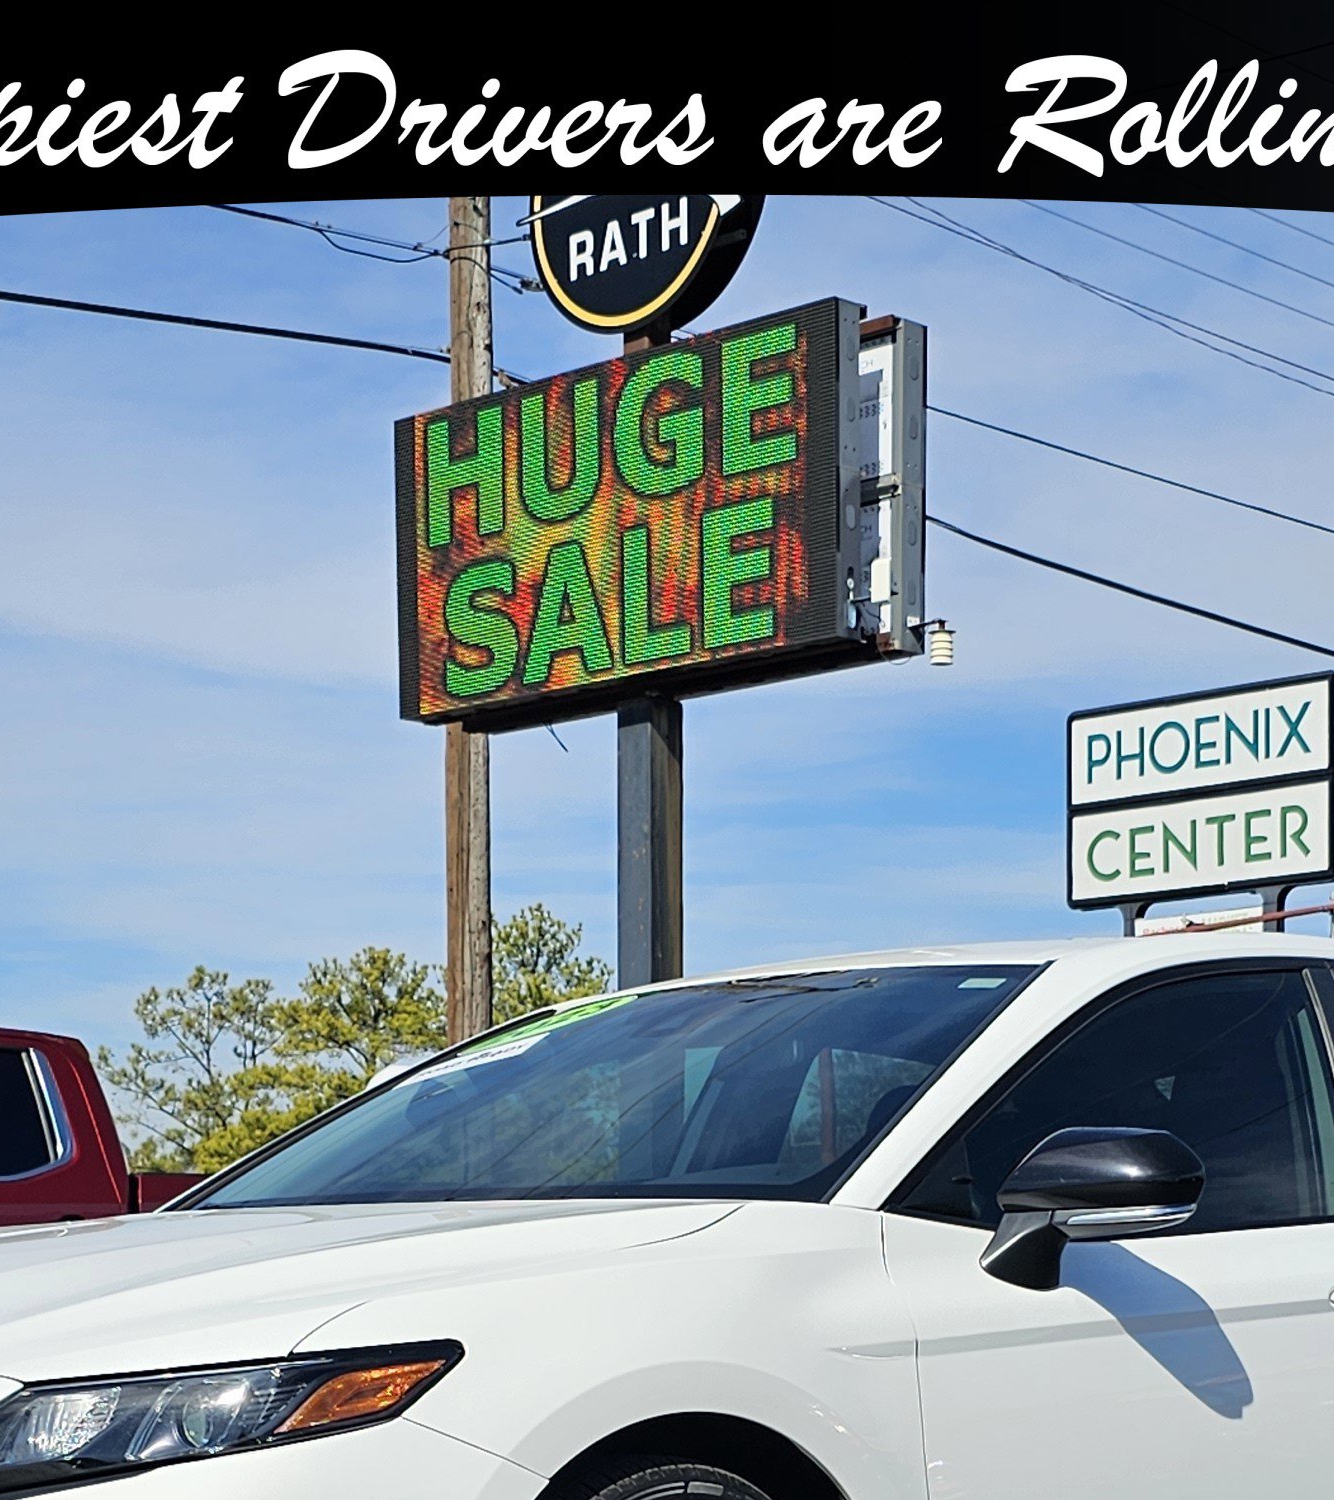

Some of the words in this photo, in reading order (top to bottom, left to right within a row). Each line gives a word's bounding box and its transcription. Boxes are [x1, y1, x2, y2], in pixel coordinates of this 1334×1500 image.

[568, 197, 689, 282] RATH
[426, 322, 798, 549] HUGE
[444, 497, 775, 698] SALE
[1087, 700, 1312, 785] PHOENIX
[1086, 804, 1312, 882] CENTER
